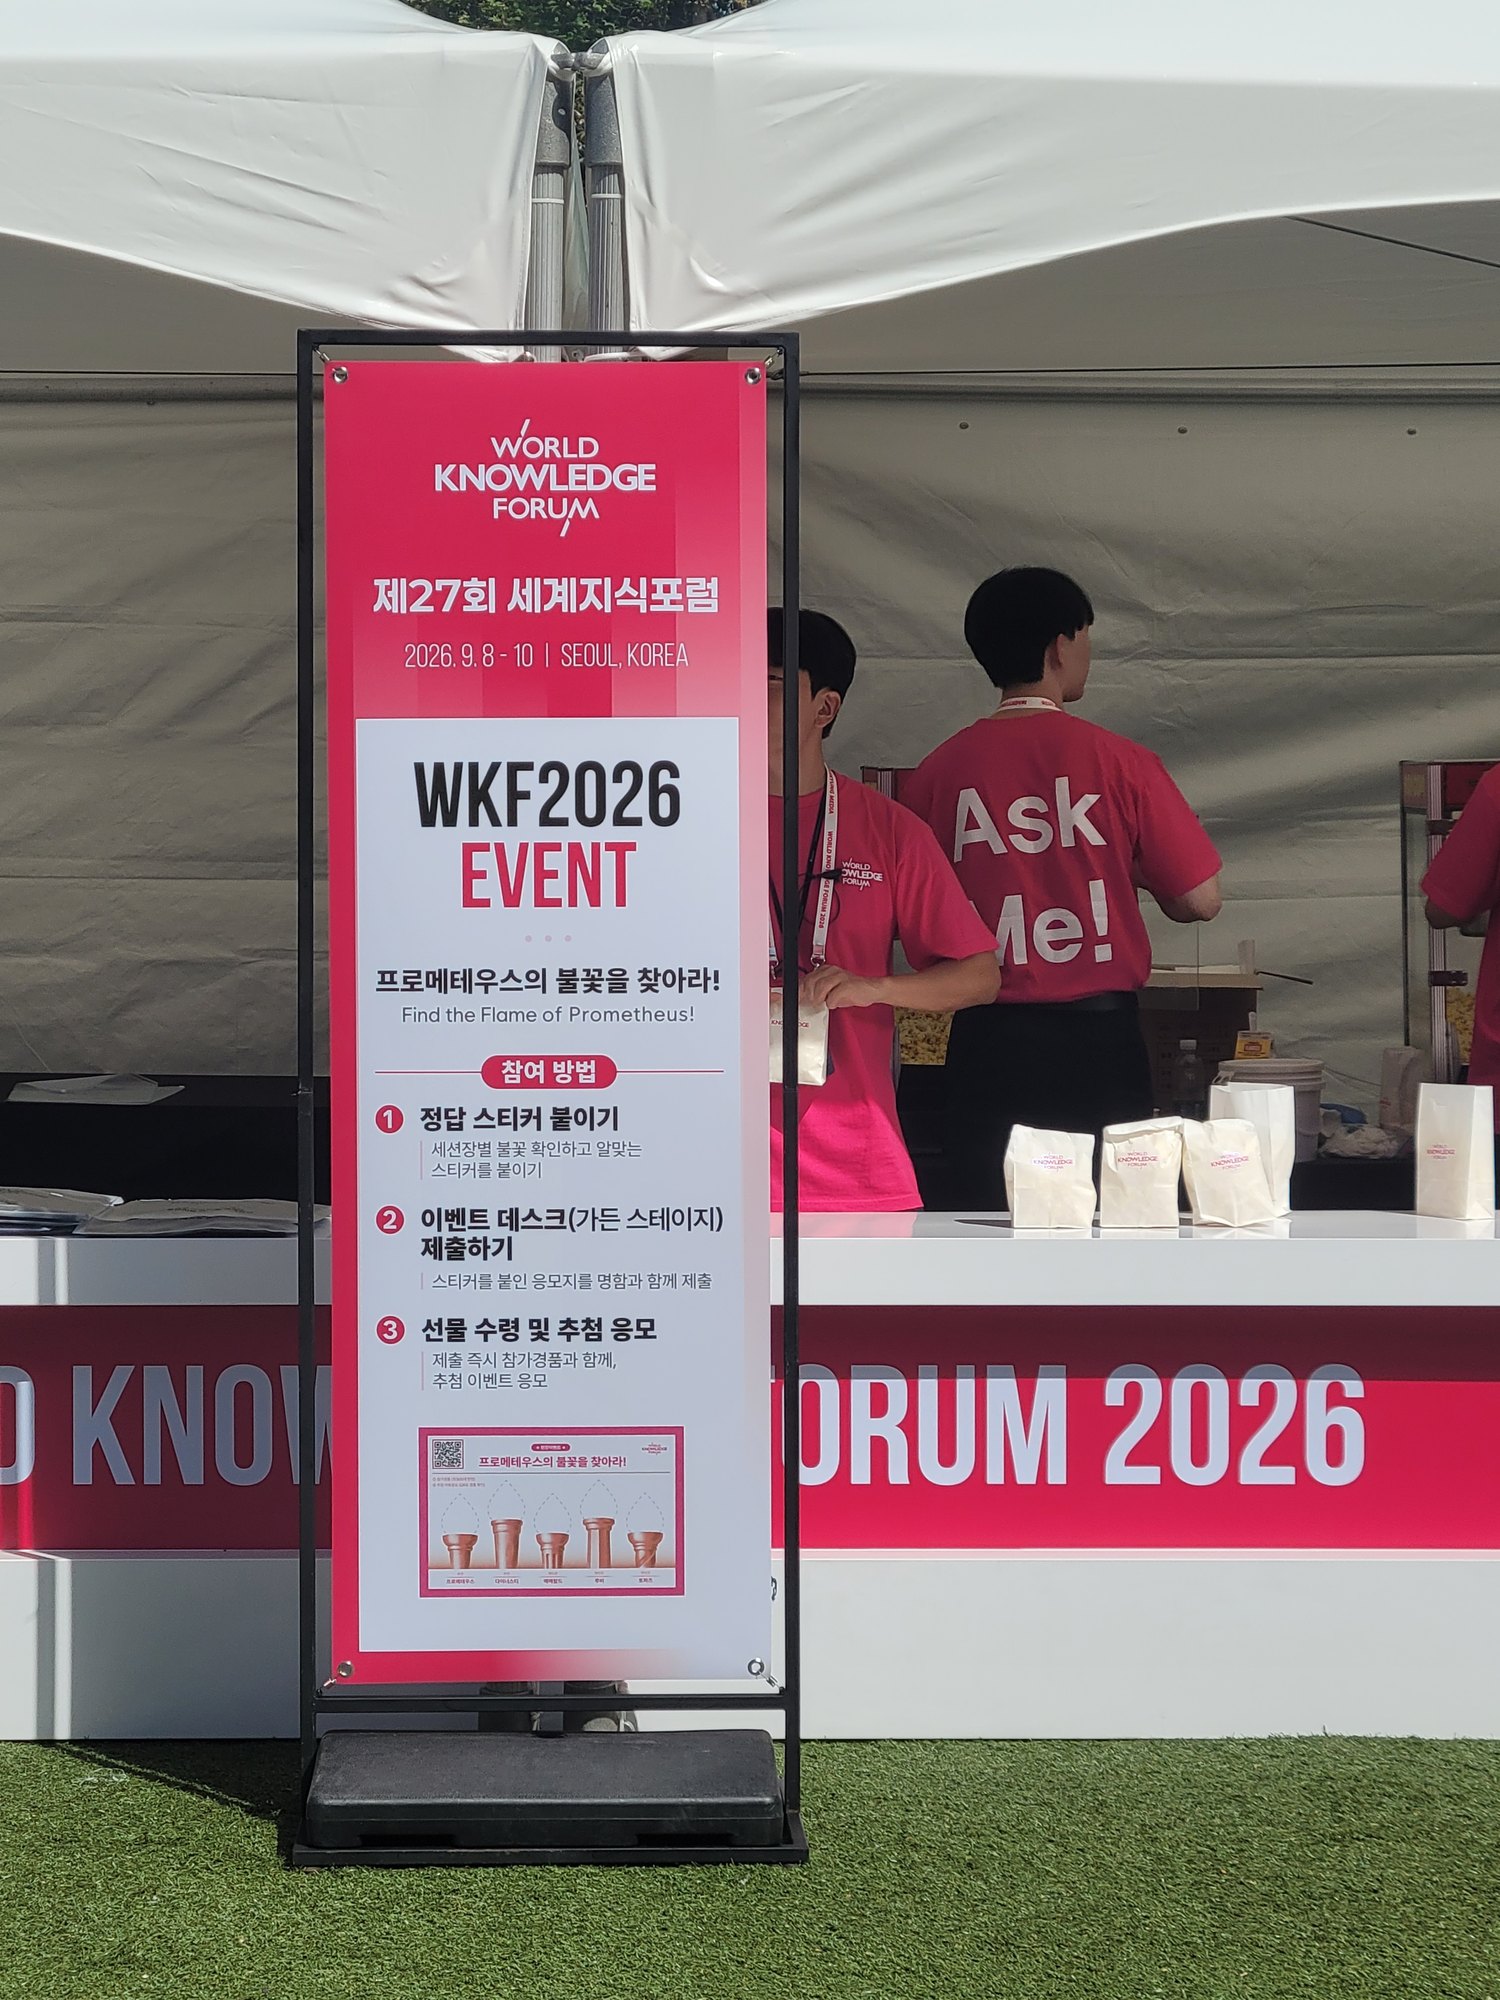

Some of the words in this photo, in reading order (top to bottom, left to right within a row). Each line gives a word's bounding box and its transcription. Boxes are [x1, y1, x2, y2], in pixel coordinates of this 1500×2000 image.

[490, 418, 600, 459] WORLD
[434, 463, 657, 492] KNOWLEDGE
[493, 497, 600, 537] FORUM
[372, 576, 496, 614] 제27회
[506, 576, 720, 614] 세계지식포럼
[404, 643, 457, 668] 2026.
[461, 643, 478, 668] 9.
[482, 643, 495, 668] 8
[513, 643, 534, 668] 10
[560, 643, 623, 671] SEOUL,
[626, 643, 689, 668] KOREA
[413, 760, 682, 829] WKF2026
[952, 775, 1108, 864] Ask
[826, 831, 834, 854] WORLD
[461, 841, 638, 909] EVENT
[842, 857, 871, 871] WORLD
[842, 878, 871, 891] FORUM
[820, 889, 830, 913] FORUM
[818, 913, 826, 929] 2026
[967, 878, 1115, 967] Me!
[374, 967, 548, 996] 프로메테우스의
[555, 967, 630, 995] 불꽃을
[636, 967, 721, 995] 찾아라!
[401, 1006, 440, 1024] Find
[445, 1006, 476, 1024] the
[480, 1006, 538, 1024] Flame
[542, 1006, 563, 1024] of
[569, 1006, 695, 1024] Prometheus!
[500, 1059, 546, 1086] 참여
[552, 1058, 597, 1085] 방법
[420, 1106, 466, 1133] 정답
[472, 1106, 544, 1132] 스티커
[549, 1106, 620, 1132] 붙이기
[431, 1140, 492, 1158] 세션장별
[496, 1140, 527, 1158] 불꽃
[530, 1140, 592, 1158] 확인하고
[596, 1140, 643, 1158] 알맞는
[1117, 1155, 1159, 1163] KNOWLEDGE
[431, 1161, 492, 1180] 스티커를
[496, 1161, 543, 1180] 붙이기
[420, 1207, 491, 1233] 이벤트
[497, 1206, 621, 1234] 데스크(가든
[626, 1206, 724, 1233] 스테이지)
[421, 1235, 514, 1262] 제출하기
[431, 1272, 493, 1291] 스티커를
[496, 1272, 528, 1291] 붙인
[531, 1272, 593, 1291] 응모지를
[597, 1272, 644, 1291] 명함과
[647, 1272, 678, 1291] 함께
[681, 1272, 713, 1291] 제출
[421, 1317, 468, 1344] 선물
[474, 1317, 522, 1343] 수령
[528, 1317, 551, 1343] 및
[557, 1316, 604, 1342] 추첨
[610, 1316, 657, 1342] 응모
[432, 1351, 463, 1370] 제출
[467, 1351, 498, 1370] 즉시
[501, 1351, 578, 1369] 참가경품과
[582, 1350, 617, 1371] 함께,
[432, 1371, 463, 1390] 추첨
[467, 1371, 514, 1390] 이벤트
[516, 1371, 548, 1390] 응모
[770, 1363, 1068, 1487] ORUM
[1102, 1363, 1367, 1487] 2026
[478, 1456, 554, 1469] 프로메테우스의
[555, 1455, 589, 1469] 불꽃을
[590, 1455, 627, 1468] 찾아라!
